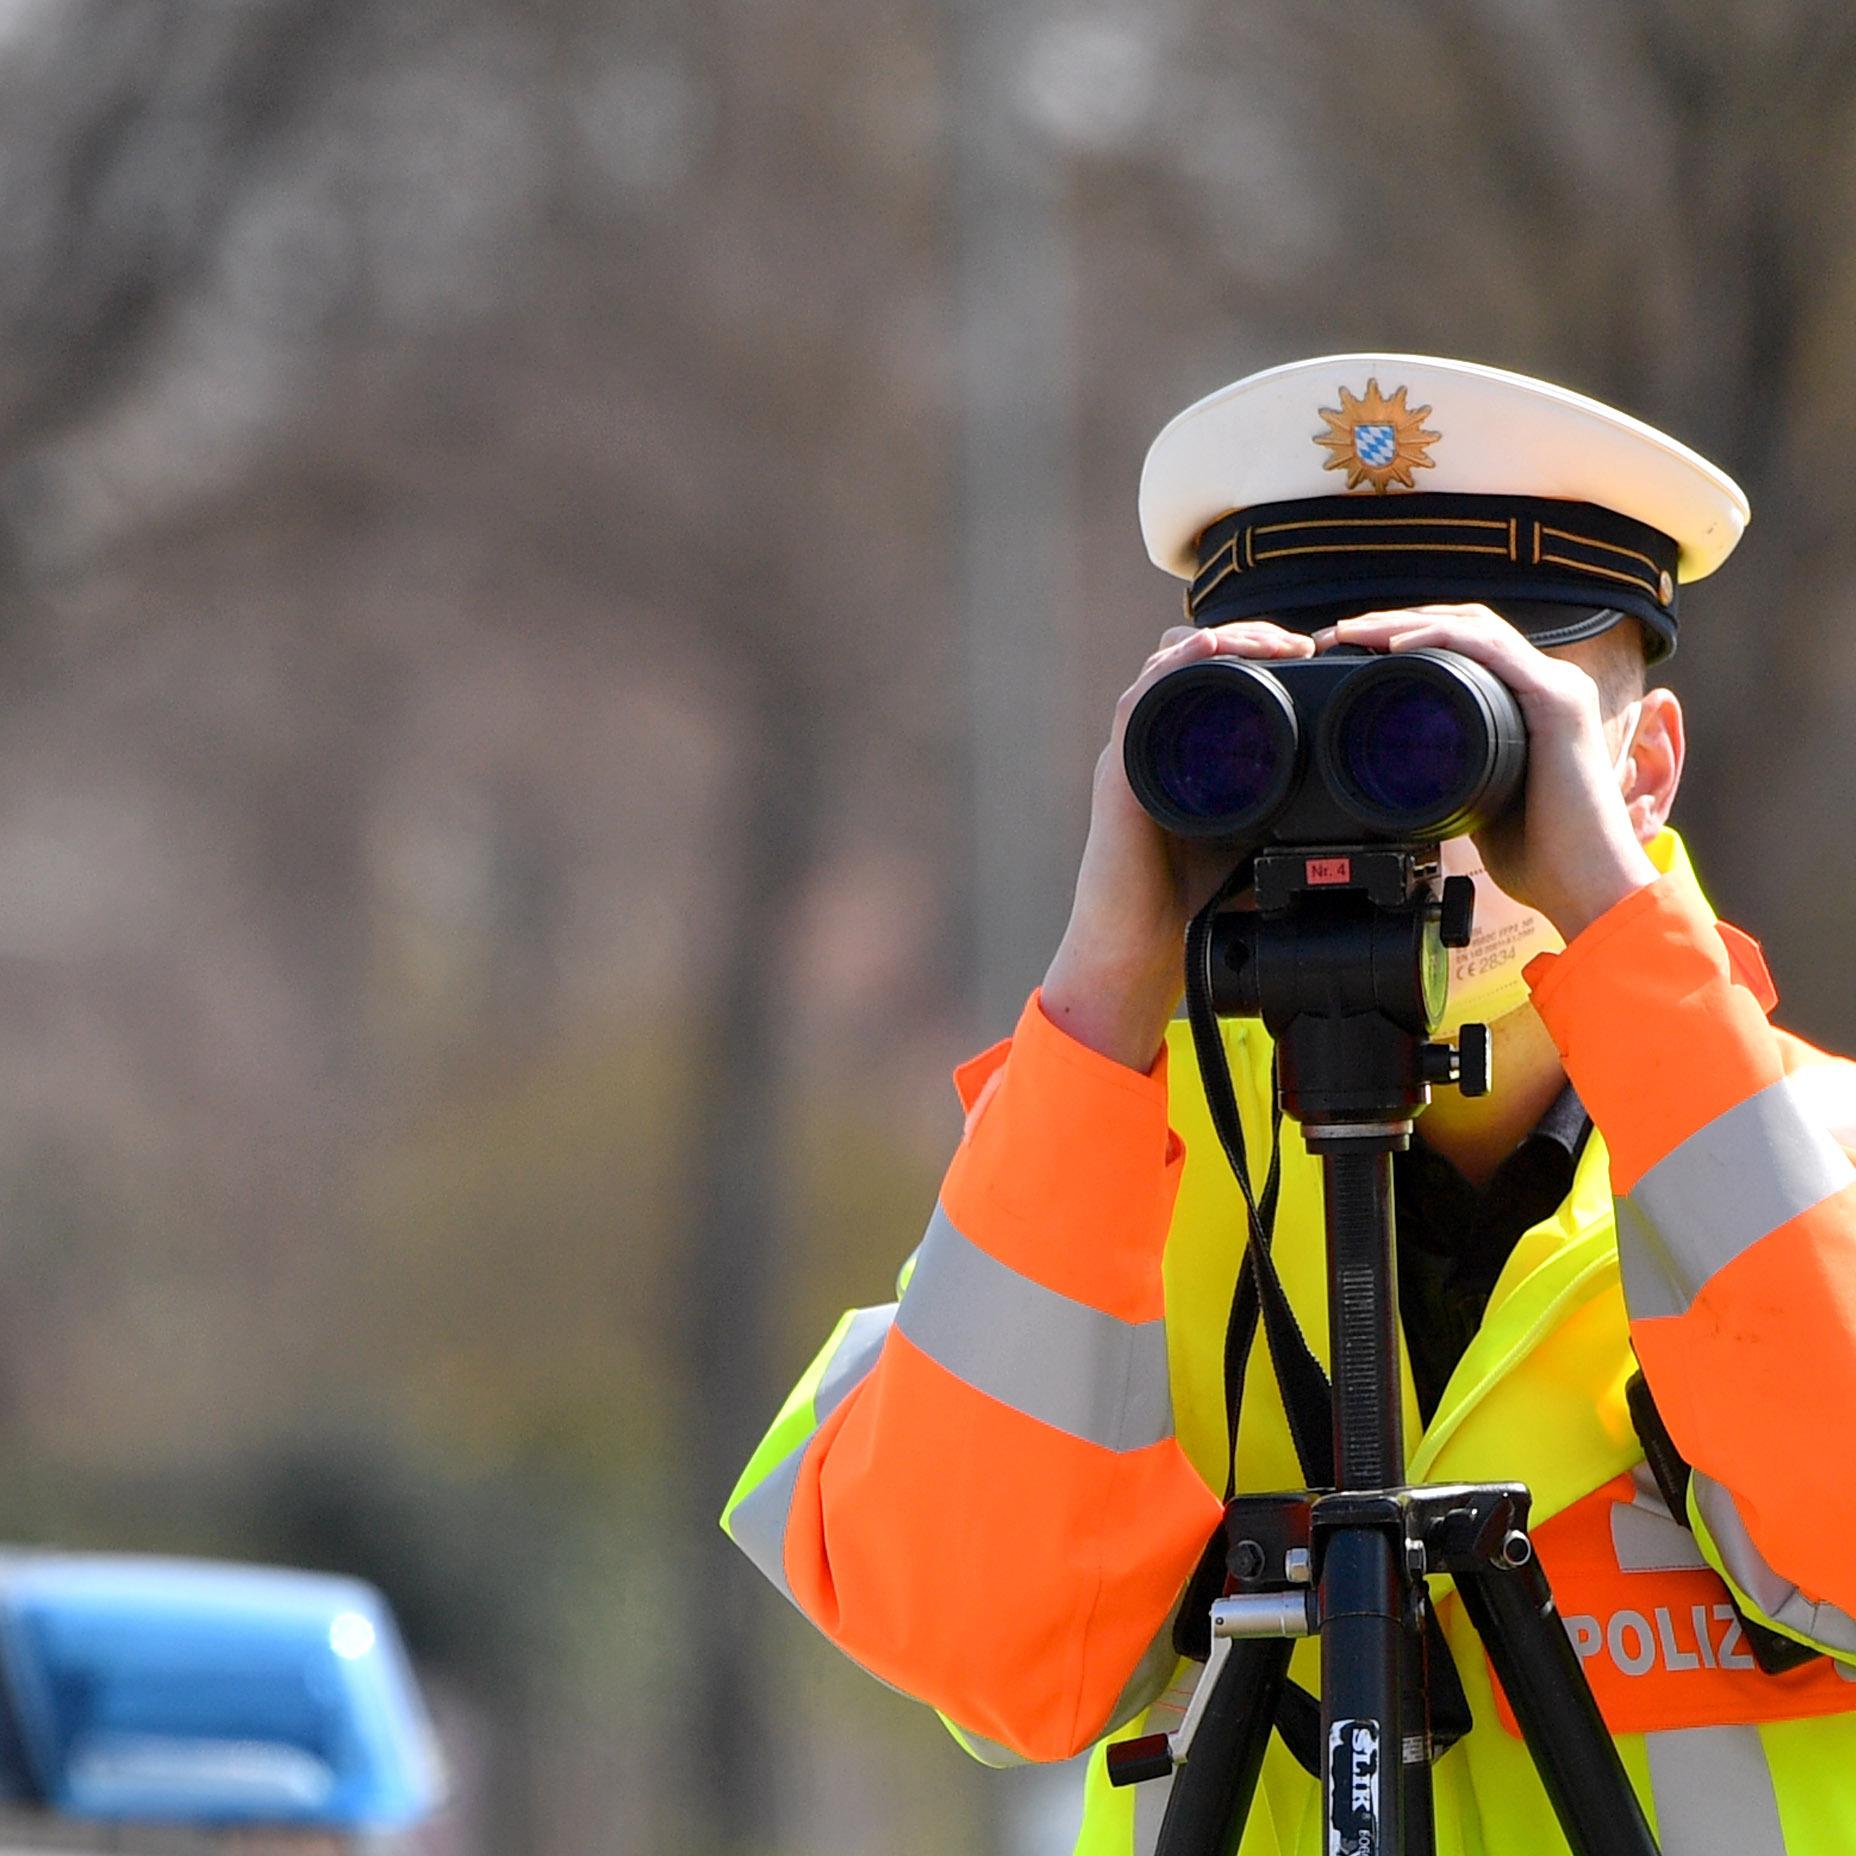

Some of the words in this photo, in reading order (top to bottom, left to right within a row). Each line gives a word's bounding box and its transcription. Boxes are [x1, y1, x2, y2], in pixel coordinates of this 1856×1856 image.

[1311, 864, 1333, 877] Nr.
[1337, 863, 1346, 876] 4
[1563, 1603, 1756, 1677] POLIZ
[1351, 1728, 1370, 1812] SLIK
